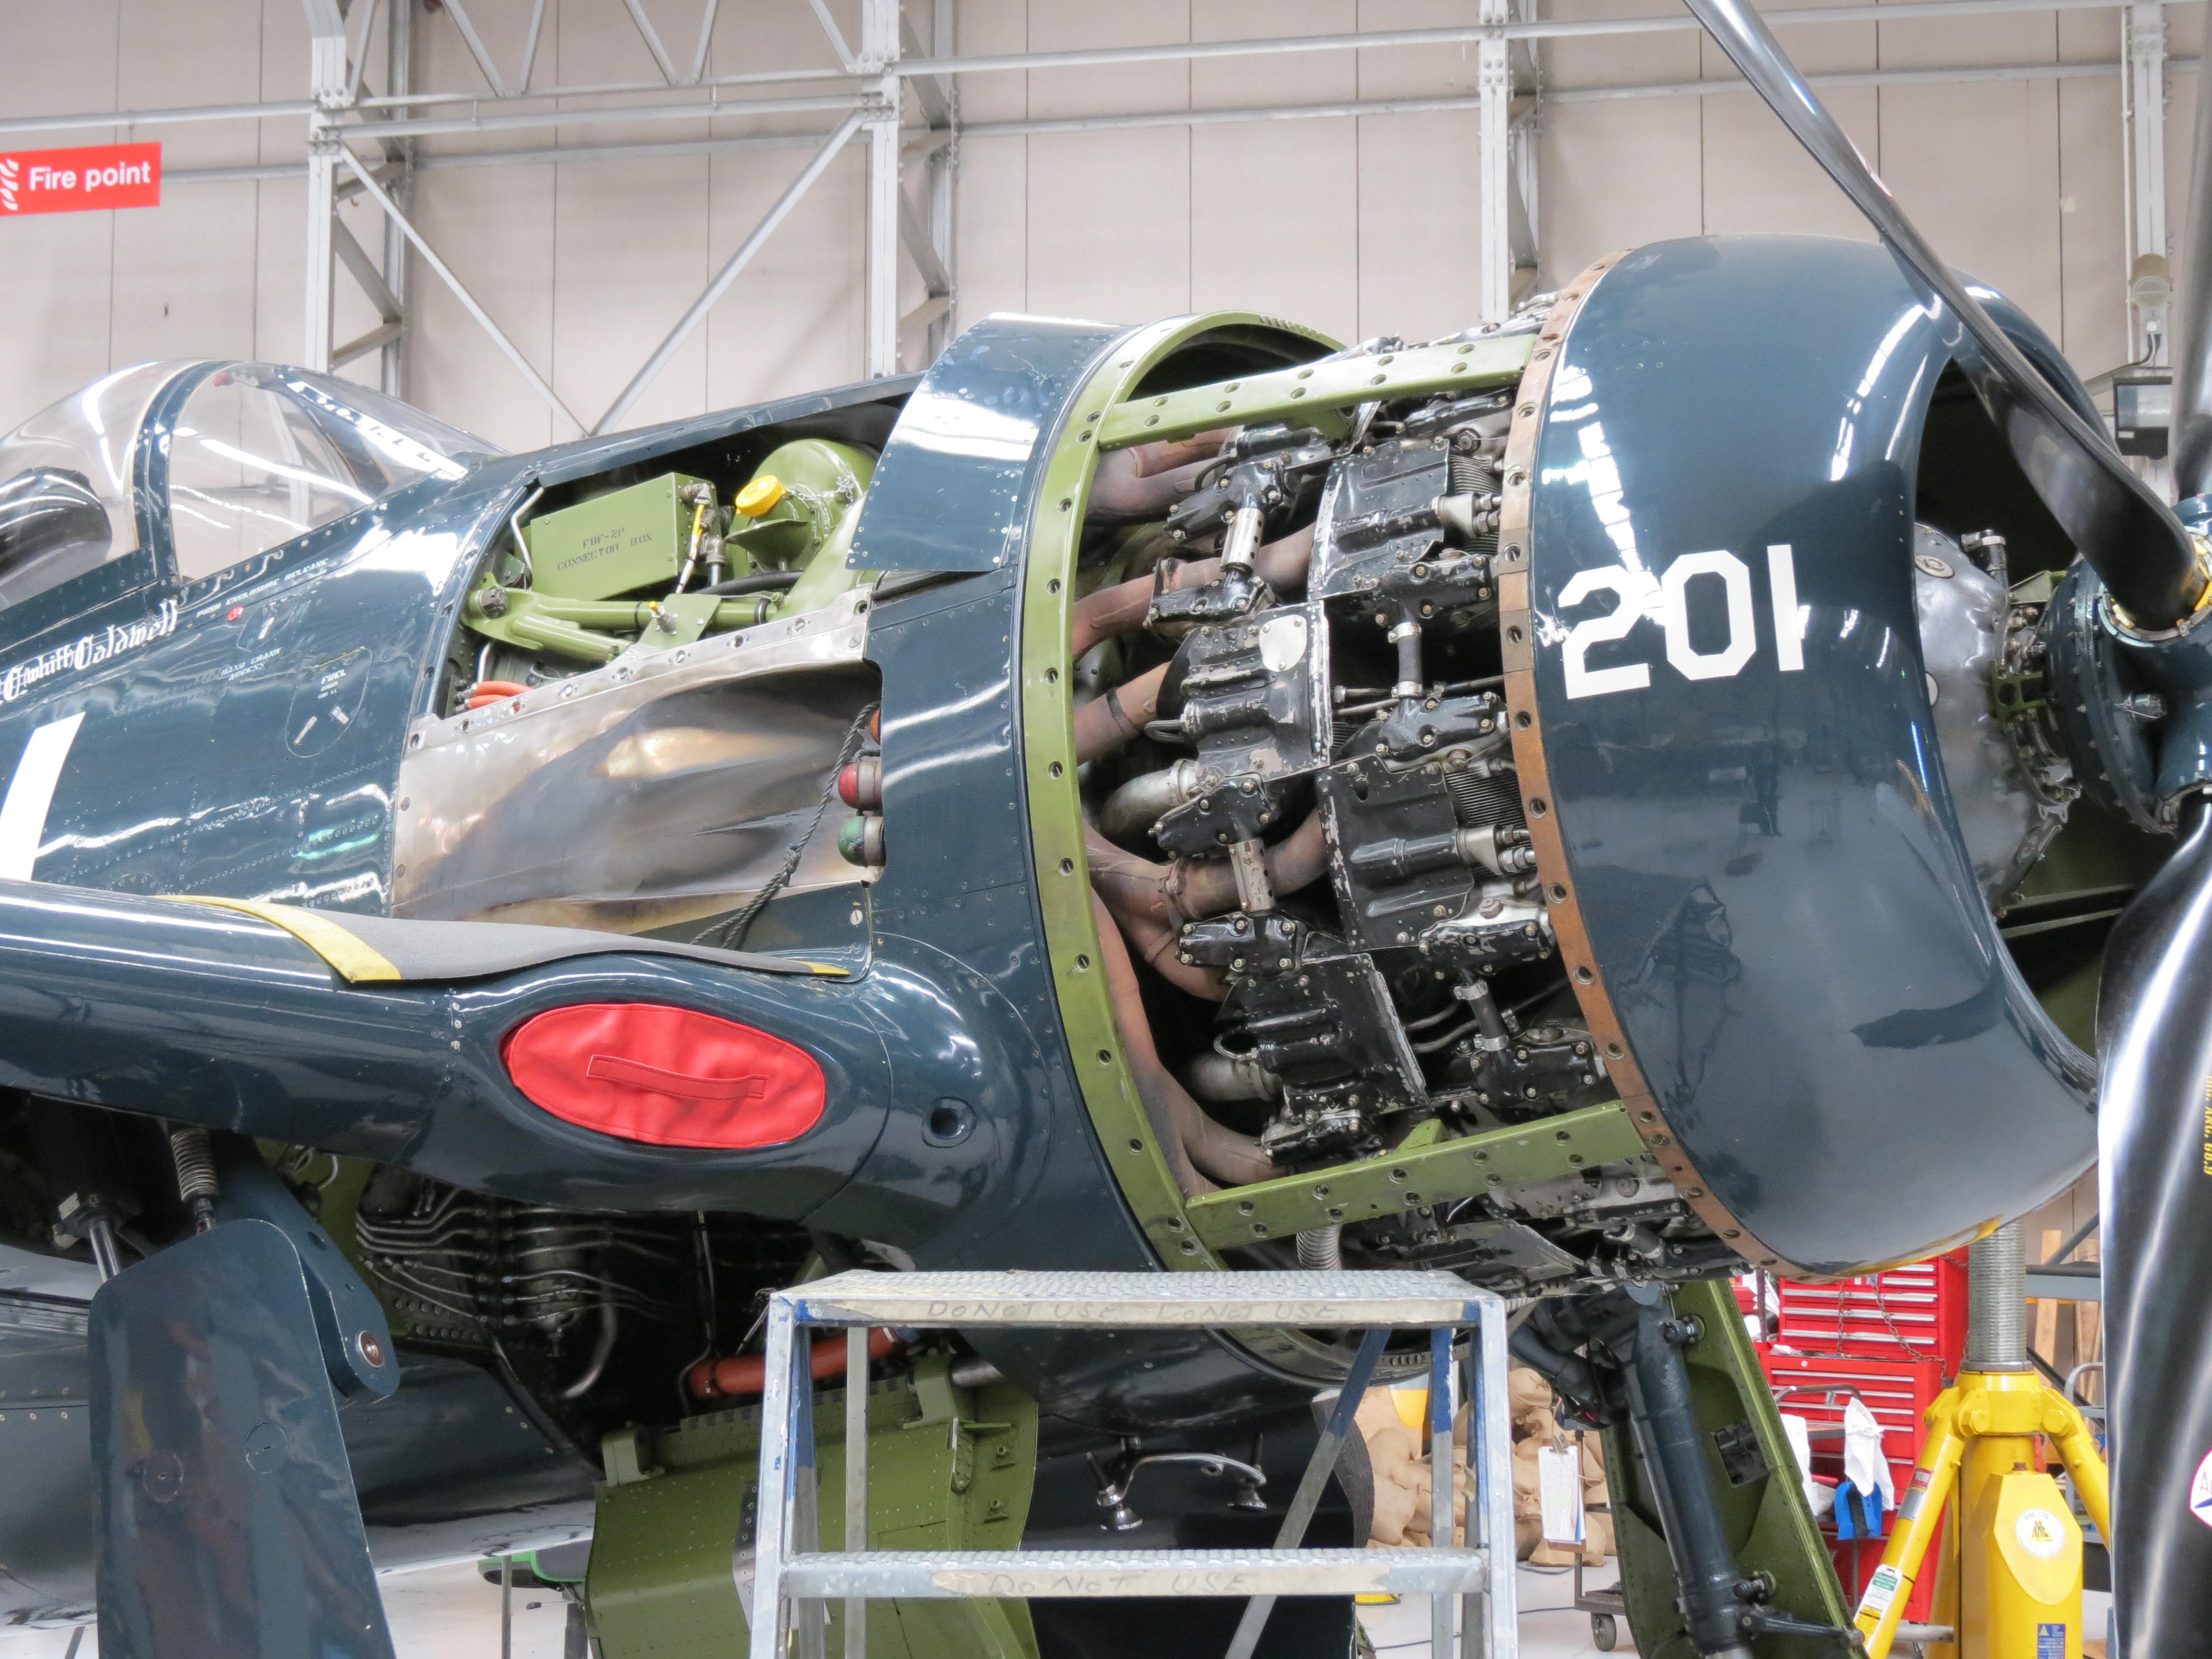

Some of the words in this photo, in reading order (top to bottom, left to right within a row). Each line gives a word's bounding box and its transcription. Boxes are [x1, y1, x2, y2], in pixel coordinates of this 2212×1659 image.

[29, 166, 77, 191] Fire
[85, 161, 151, 192] point
[557, 543, 619, 571] CONNECTOR
[629, 531, 653, 547] BOX
[196, 603, 222, 618] PUSH
[284, 558, 329, 581] RELEASE
[74, 599, 178, 670] Caldwell
[1557, 544, 1805, 700] 201
[321, 669, 346, 685] FUEL
